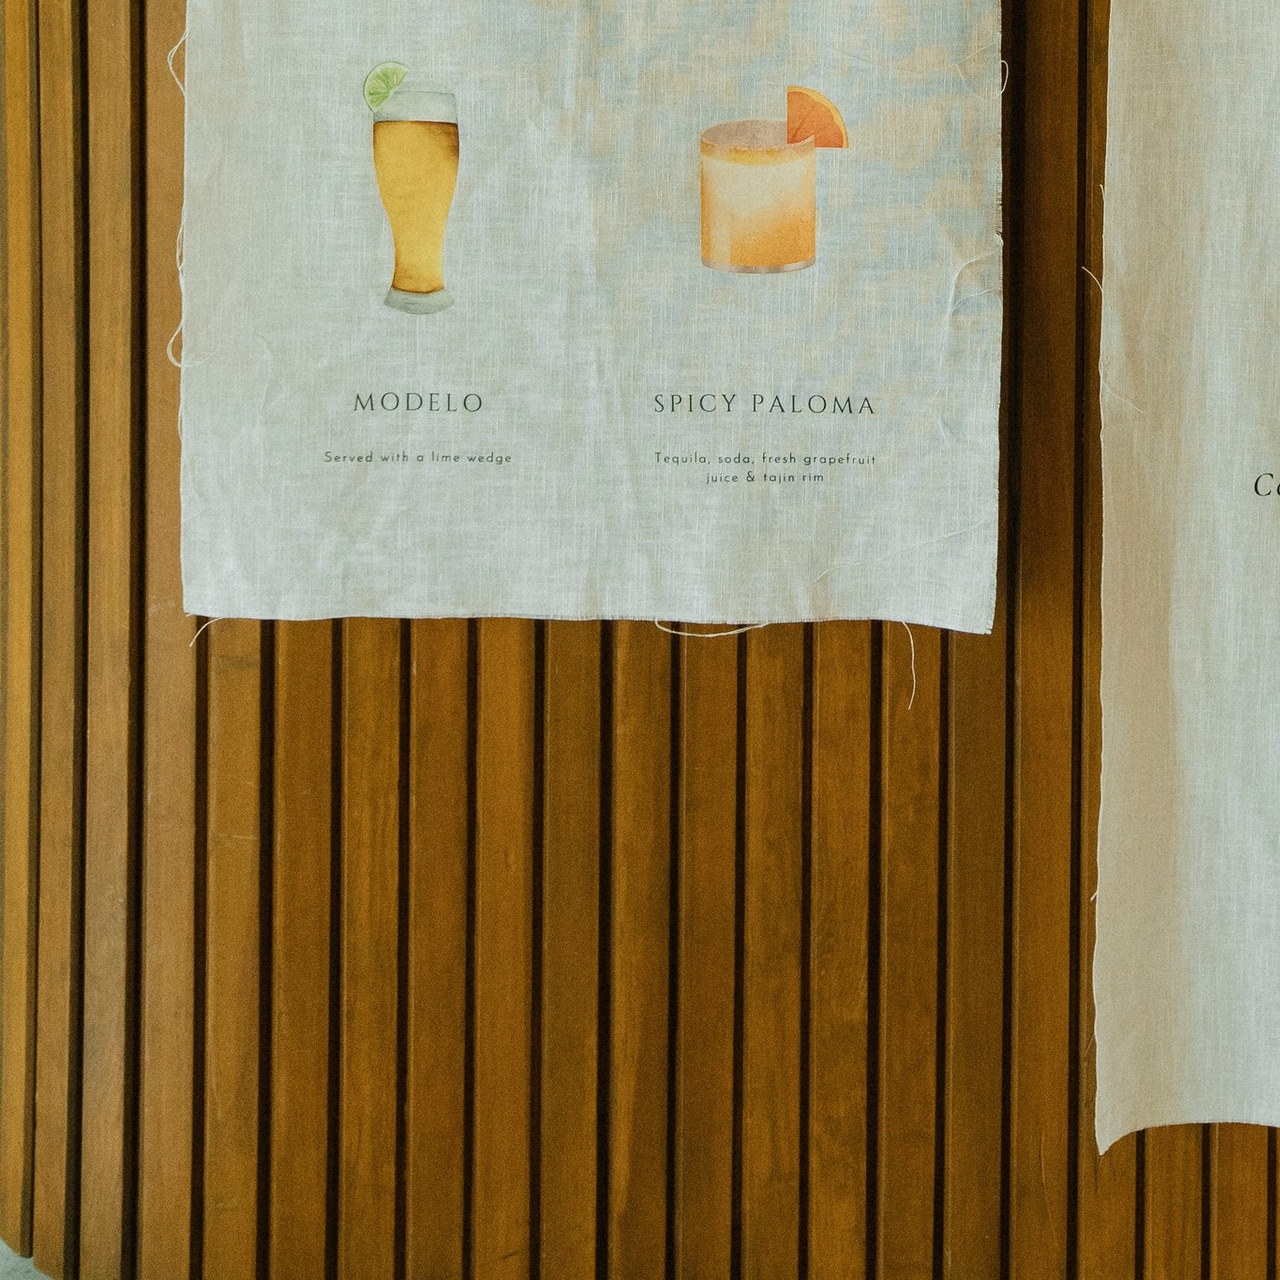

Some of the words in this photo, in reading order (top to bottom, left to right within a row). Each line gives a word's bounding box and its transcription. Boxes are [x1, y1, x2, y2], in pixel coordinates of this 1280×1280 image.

[353, 391, 483, 413] MODELO
[654, 393, 737, 413] SPICY
[752, 393, 875, 415] PALOMA
[324, 450, 374, 463] Served
[379, 450, 409, 463] with
[415, 454, 425, 463] a
[431, 450, 461, 463] lime
[466, 450, 512, 466] wedge
[654, 451, 712, 467] Tequila,
[717, 451, 755, 466] soda,
[761, 451, 797, 464] fresh
[802, 452, 876, 467] grapefruit
[705, 472, 739, 485] juice
[745, 470, 756, 483] &
[801, 473, 824, 482] rim
